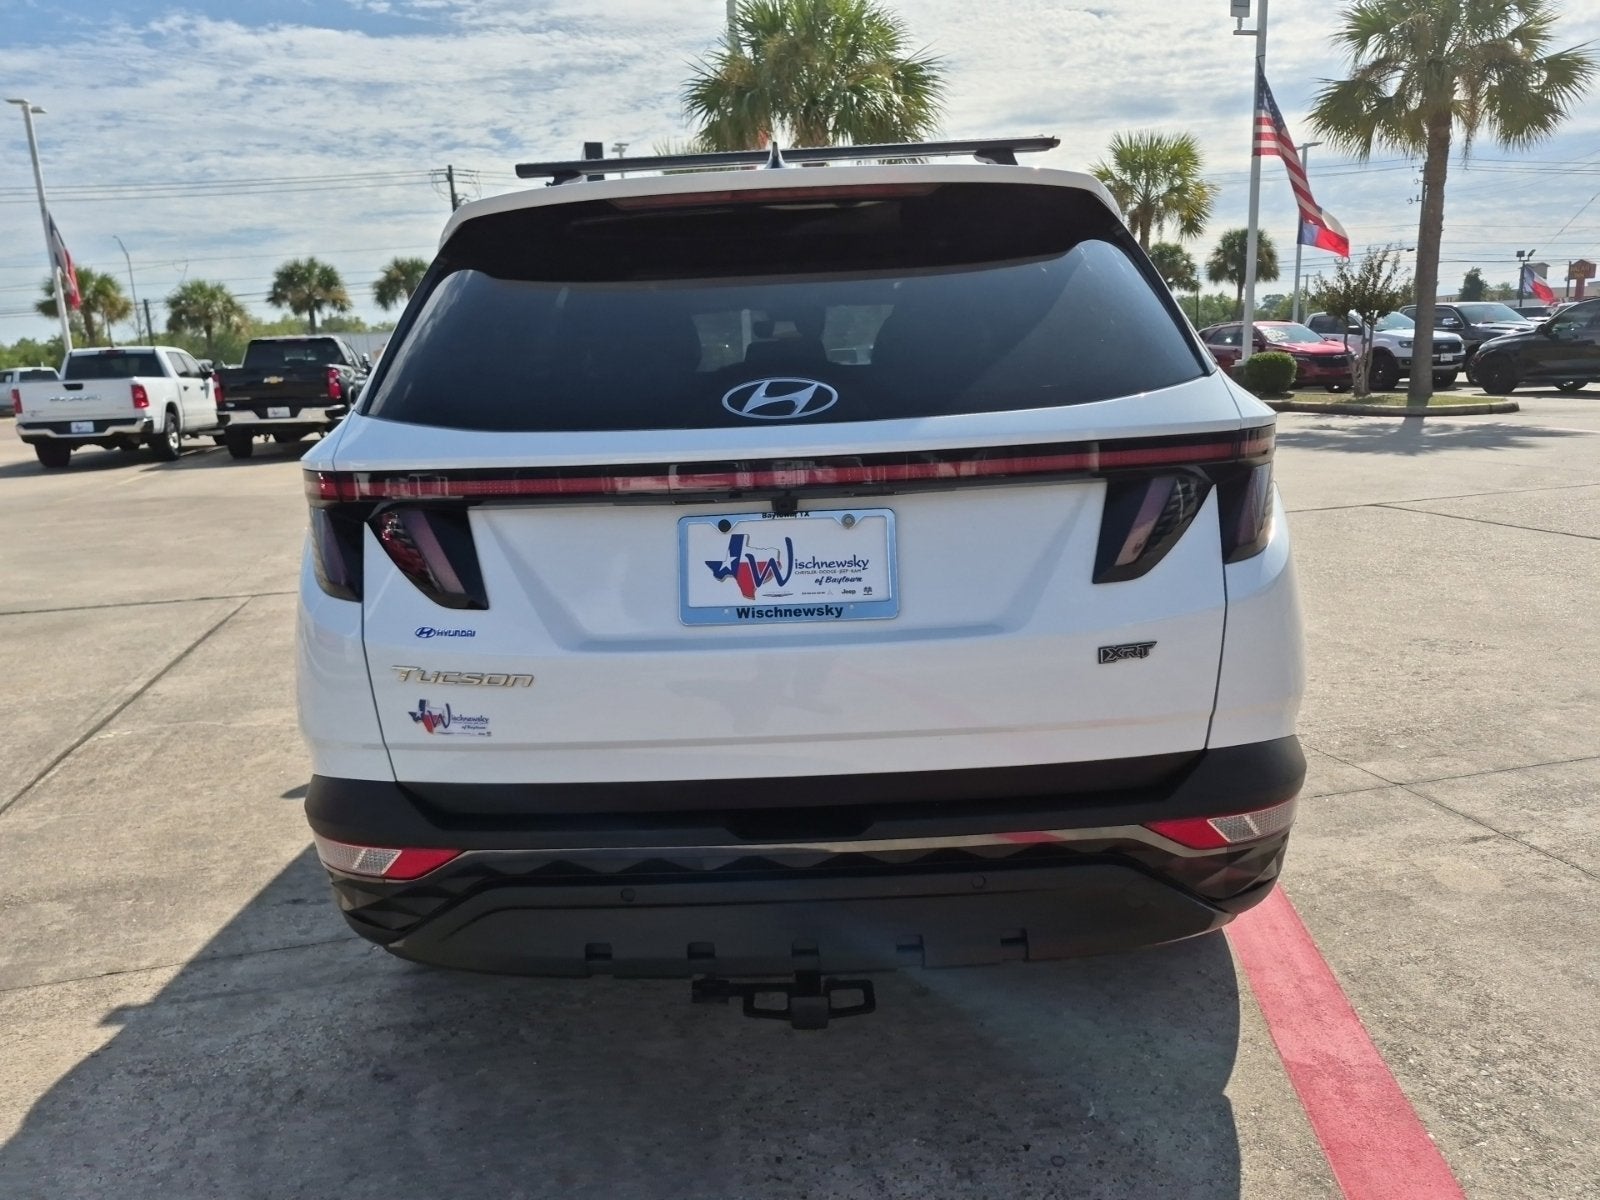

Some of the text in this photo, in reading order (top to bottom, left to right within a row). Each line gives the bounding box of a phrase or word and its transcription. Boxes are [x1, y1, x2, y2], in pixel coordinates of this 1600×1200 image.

[814, 575, 863, 585] of Baytown
[736, 604, 844, 619] Wischnewsky
[436, 629, 476, 637] HYUNDAI
